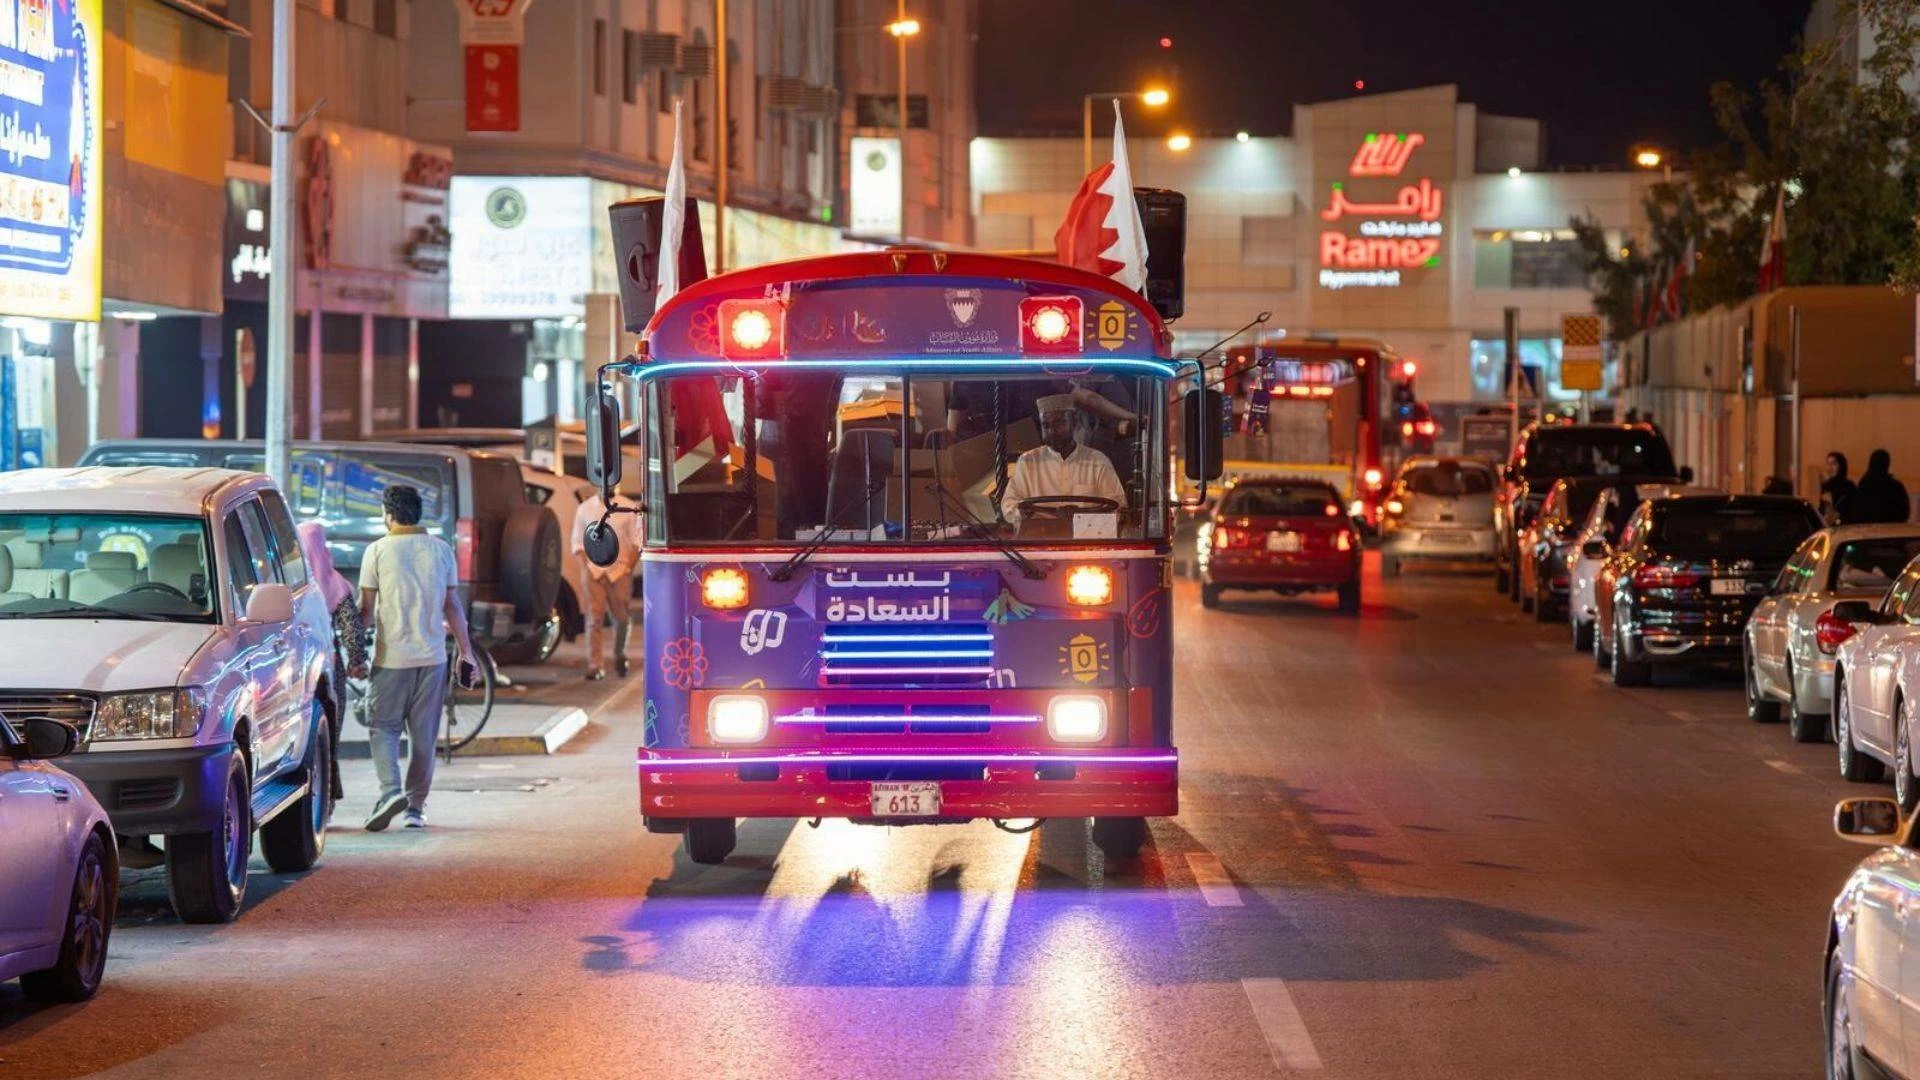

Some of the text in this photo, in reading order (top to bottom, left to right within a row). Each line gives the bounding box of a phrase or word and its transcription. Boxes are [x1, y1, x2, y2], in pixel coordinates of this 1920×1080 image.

[1320, 178, 1442, 221] رامز
[1320, 231, 1441, 268] Ramez
[826, 596, 950, 622] السعادة
[888, 795, 920, 813] 613
